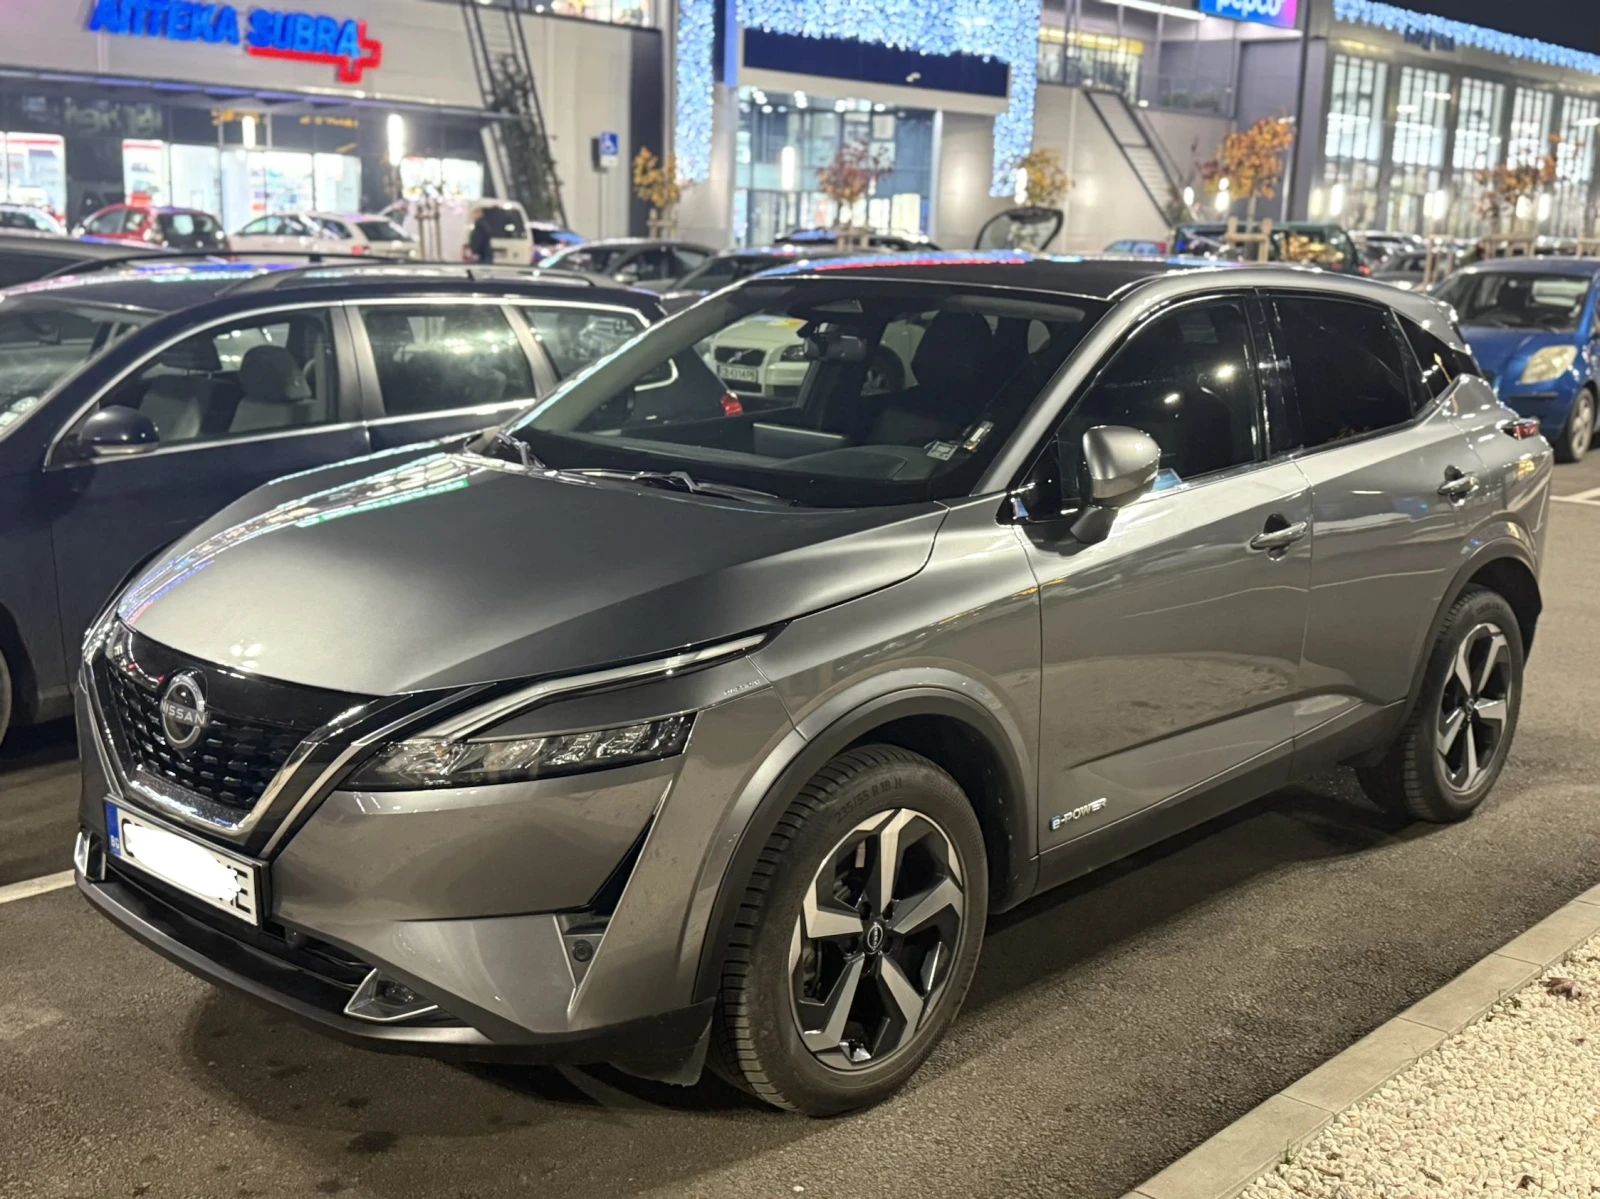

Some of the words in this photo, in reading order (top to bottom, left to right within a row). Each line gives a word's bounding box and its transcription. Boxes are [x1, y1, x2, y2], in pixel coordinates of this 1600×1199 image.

[248, 9, 360, 58] SUBRA
[162, 699, 206, 725] NISSAN
[110, 834, 120, 850] BG
